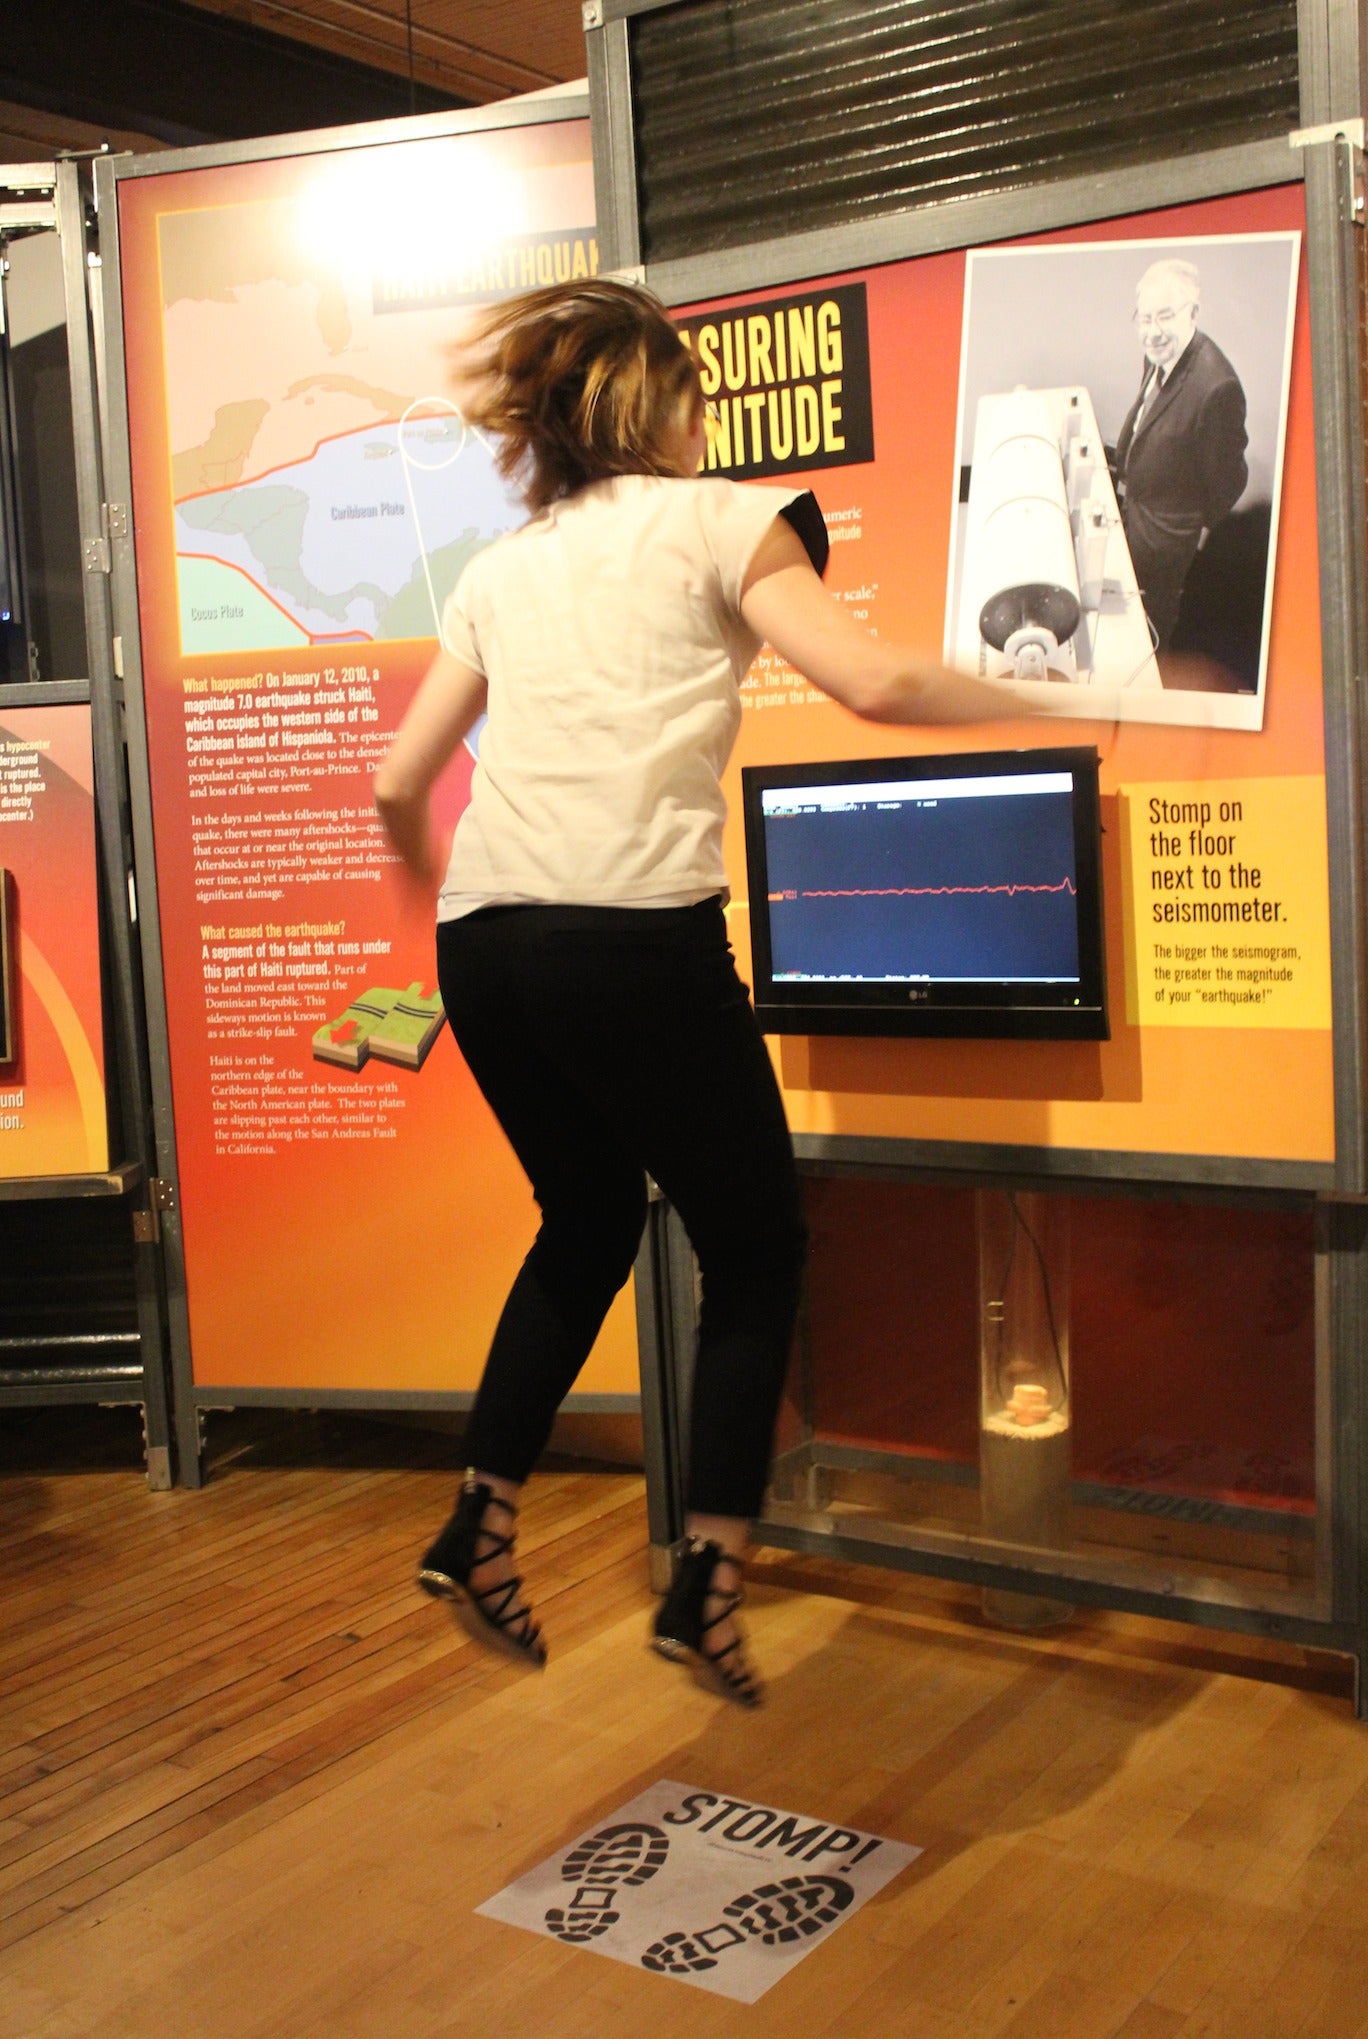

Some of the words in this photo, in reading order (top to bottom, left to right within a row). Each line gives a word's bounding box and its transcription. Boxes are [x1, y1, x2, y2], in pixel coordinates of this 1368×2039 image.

[680, 300, 843, 396] SURING
[700, 379, 845, 471] NITUDE
[331, 503, 377, 520] Caribbean
[381, 502, 405, 517] Plate
[823, 506, 862, 522] umeric
[191, 607, 218, 621] Cocos
[220, 605, 244, 619] Plate
[758, 655, 772, 671] by
[182, 678, 208, 693] What
[210, 674, 264, 694] happened?
[265, 673, 280, 688] On
[282, 671, 320, 690] January
[324, 670, 339, 686] 12,
[341, 668, 370, 684] 2010,
[372, 670, 380, 681] a
[764, 671, 780, 687] The
[184, 696, 235, 715] magnitude
[238, 695, 253, 709] 7.0
[254, 691, 311, 711] earthquake
[313, 689, 345, 705] struck
[348, 688, 376, 704] Haiti,
[755, 692, 786, 709] greater
[789, 689, 805, 704] the
[185, 716, 214, 732] which
[216, 714, 260, 733] occupies
[262, 713, 279, 728] the
[280, 710, 322, 726] western
[323, 709, 345, 724] side
[347, 708, 358, 723] of
[361, 707, 379, 722] the
[6, 740, 51, 754] hypocenter
[186, 735, 234, 752] Caribbean
[236, 733, 266, 749] island
[268, 732, 278, 747] of
[281, 728, 337, 748] Hispaniola.
[339, 731, 358, 742] The
[187, 756, 197, 767] of
[198, 755, 214, 766] the
[216, 753, 244, 768] quake
[246, 754, 264, 763] was
[265, 749, 299, 762] located
[301, 748, 325, 760] close
[326, 747, 337, 758] to
[338, 746, 355, 757] the
[4, 767, 41, 781] ruptured.
[188, 768, 234, 784] populated
[235, 767, 266, 782] capital
[268, 766, 288, 780] city,
[290, 762, 361, 776] Port-au-Prince.
[9, 782, 23, 793] the
[24, 781, 46, 794] place
[189, 785, 207, 796] and
[209, 784, 227, 796] loss
[228, 784, 238, 795] of
[239, 783, 255, 794] life
[256, 785, 279, 793] were
[280, 783, 312, 792] severe.
[1, 796, 32, 808] directly
[191, 814, 202, 825] In
[204, 813, 219, 825] the
[220, 812, 242, 826] days
[243, 811, 262, 822] and
[264, 810, 292, 822] weeks
[293, 807, 338, 823] following
[340, 806, 356, 817] the
[1149, 797, 1211, 828] Stomp
[1219, 801, 1243, 822] on
[192, 828, 222, 843] quake,
[224, 827, 248, 838] there
[250, 829, 272, 837] were
[274, 827, 300, 839] many
[1150, 831, 1181, 856] the
[1189, 830, 1236, 856] floor
[193, 844, 211, 855] that
[213, 846, 239, 854] occur
[241, 842, 250, 853] at
[252, 845, 263, 853] or
[265, 844, 286, 852] near
[288, 840, 304, 851] the
[305, 839, 343, 853] original
[344, 837, 386, 849] location.
[194, 858, 249, 870] Aftershocks
[250, 860, 265, 868] are
[267, 855, 307, 870] typically
[309, 854, 342, 866] weaker
[344, 853, 364, 864] and
[195, 877, 214, 885] over
[216, 873, 241, 886] time,
[242, 872, 260, 884] and
[263, 872, 276, 886] yet
[278, 874, 294, 882] are
[295, 870, 330, 884] capable
[332, 869, 342, 880] of
[344, 868, 381, 882] causing
[1152, 865, 1194, 890] next
[1202, 864, 1221, 889] to
[1229, 862, 1261, 888] the
[196, 888, 243, 903] significant
[245, 887, 285, 901] damage.
[1153, 896, 1288, 923] seismometer.
[200, 925, 225, 940] What
[228, 924, 263, 939] caused
[265, 923, 282, 938] the
[284, 921, 346, 940] earthquake?
[202, 945, 209, 959] A
[211, 943, 253, 961] segment
[255, 943, 266, 957] of
[269, 942, 286, 957] the
[288, 941, 311, 956] fault
[314, 940, 334, 955] that
[337, 943, 360, 954] runs
[362, 938, 392, 954] under
[1154, 944, 1172, 959] The
[1175, 944, 1207, 961] bigger
[1211, 944, 1229, 959] the
[1232, 944, 1301, 961] seismogram,
[203, 964, 222, 978] this
[224, 963, 244, 980] part
[246, 963, 257, 977] of
[260, 962, 283, 977] Haiti
[285, 961, 332, 979] ruptured.
[334, 964, 354, 975] Part
[356, 963, 367, 974] of
[1154, 967, 1171, 981] the
[1174, 967, 1212, 983] greater
[1216, 967, 1233, 981] the
[1236, 966, 1293, 984] magnitude
[204, 982, 219, 993] the
[220, 982, 242, 993] land
[243, 981, 275, 992] moved
[276, 980, 295, 991] east
[296, 980, 330, 991] toward
[331, 979, 348, 990] the
[1155, 988, 1165, 1003] of
[1169, 990, 1191, 1005] your
[663, 1793, 884, 1873] STOMP!
